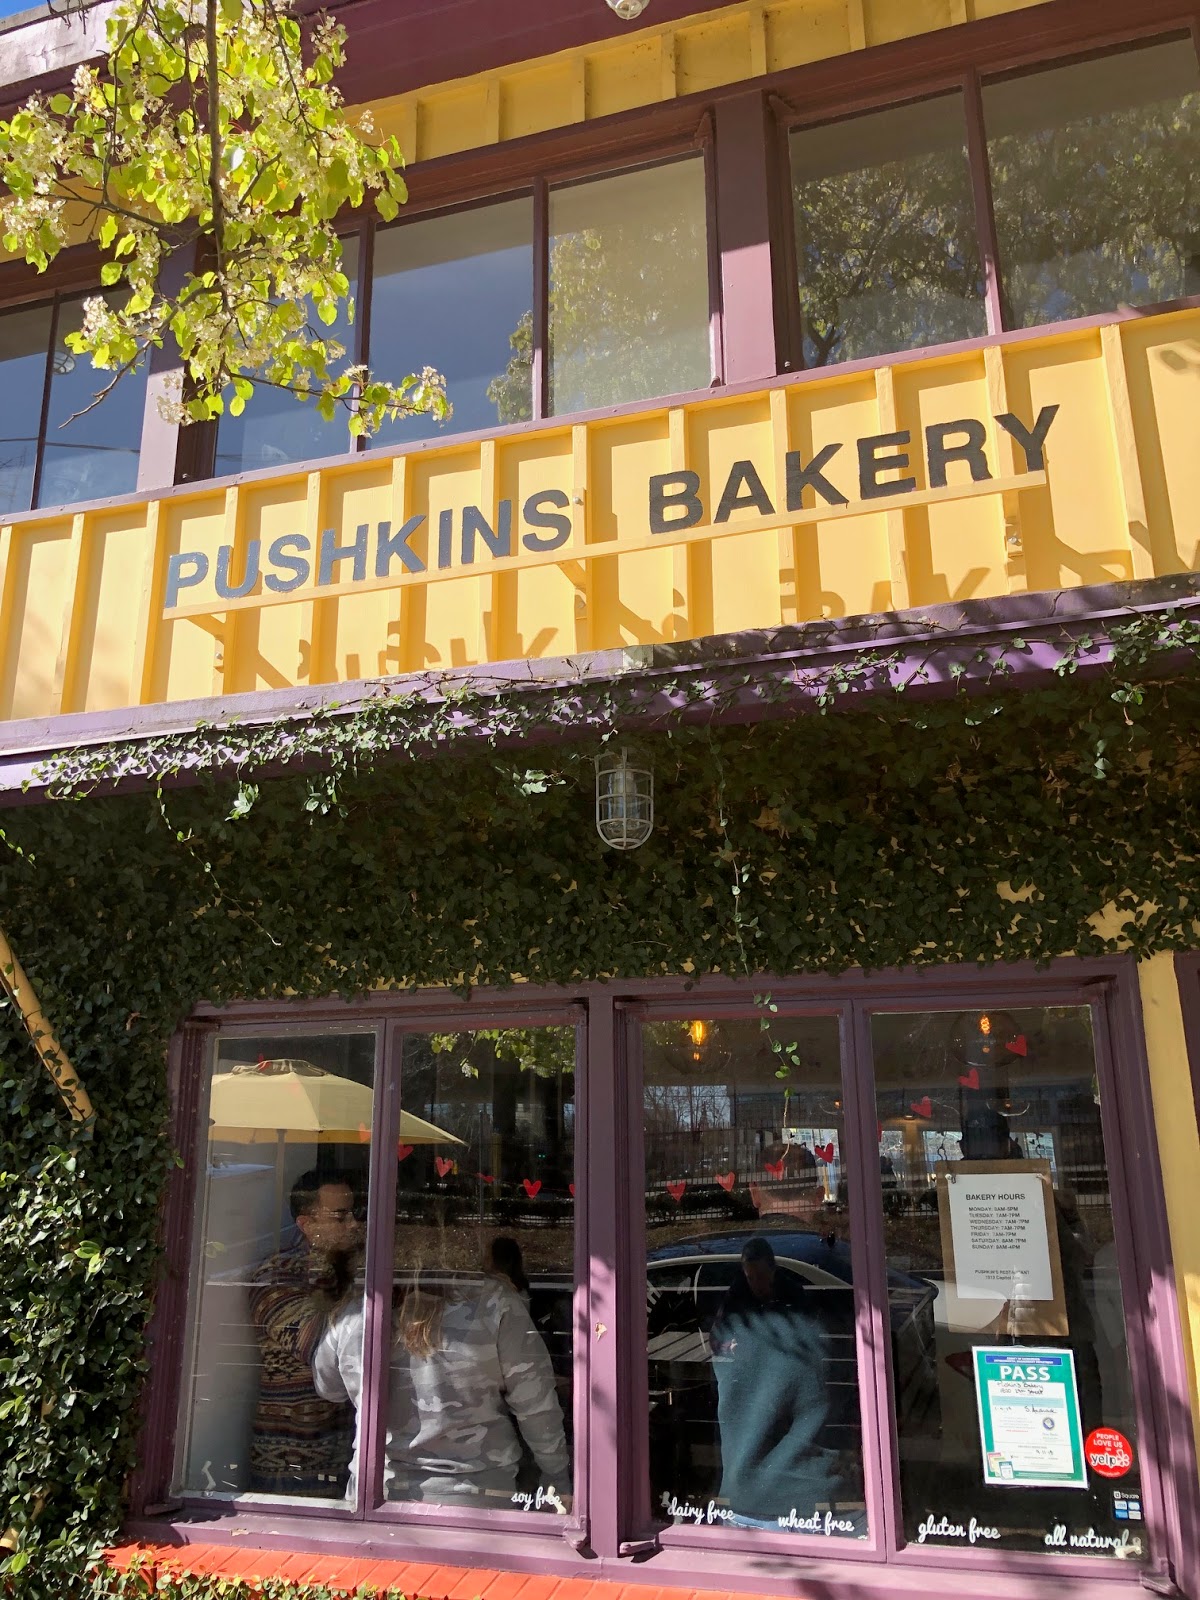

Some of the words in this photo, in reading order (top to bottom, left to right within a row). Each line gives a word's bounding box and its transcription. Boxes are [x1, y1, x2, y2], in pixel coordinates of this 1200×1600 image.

[165, 489, 572, 608] PUSHKINS
[648, 404, 1060, 534] BAKERY
[965, 1193, 996, 1201] BAKERY
[1000, 1365, 1051, 1381] PASS
[1093, 1439, 1112, 1447] LOVE
[1096, 1432, 1120, 1441] PEOPLE
[1090, 1453, 1117, 1468] yelp
[511, 1492, 534, 1511] soy
[1121, 1492, 1140, 1500] Square
[667, 1497, 705, 1525] dairy
[706, 1499, 736, 1525] free
[778, 1508, 822, 1531] wheat
[823, 1511, 855, 1536] free
[918, 1514, 966, 1543] gluten
[968, 1517, 1001, 1544] free
[1044, 1524, 1067, 1546] all
[1069, 1527, 1130, 1549] natural
